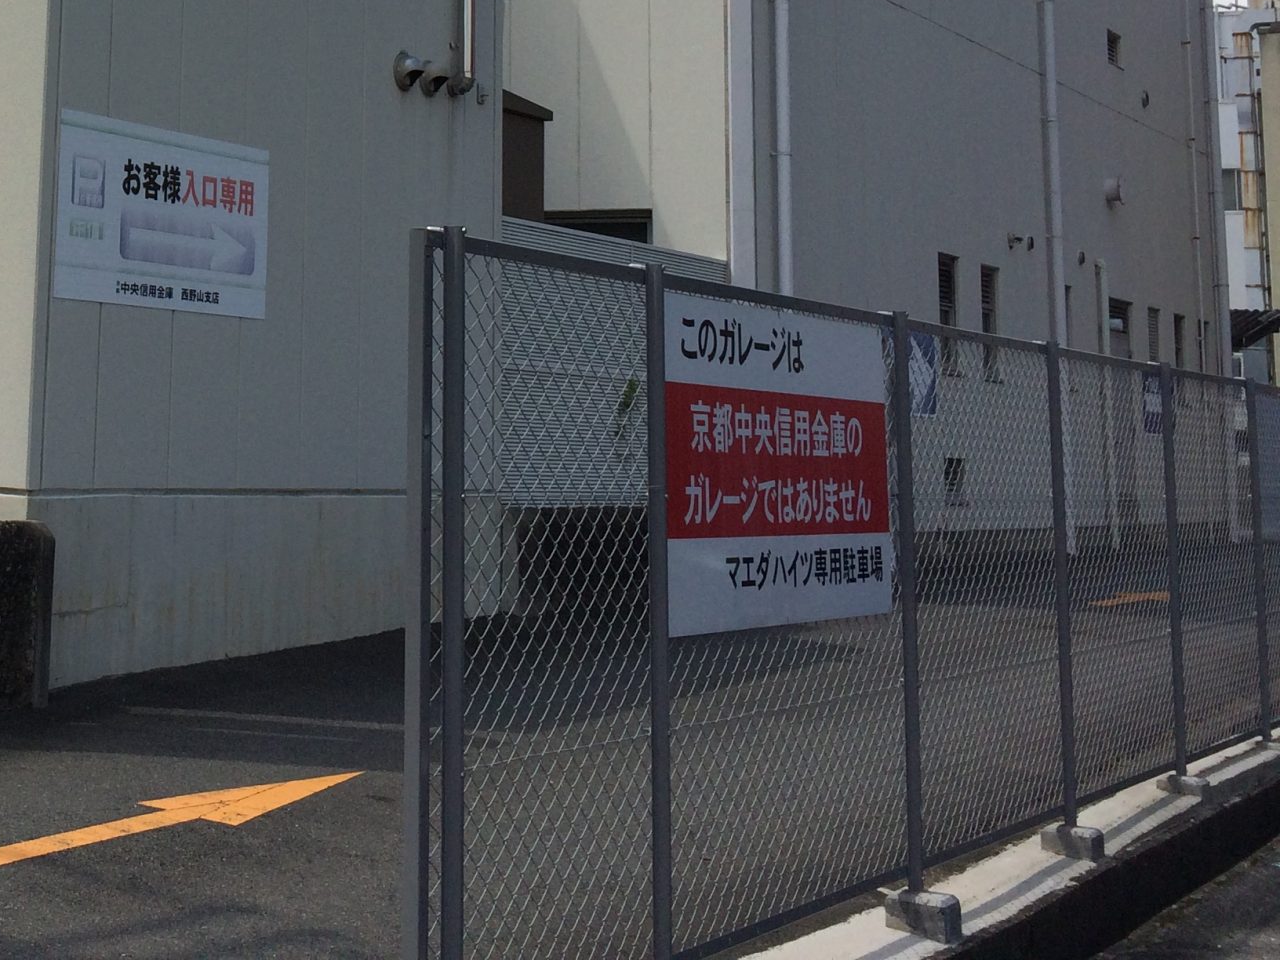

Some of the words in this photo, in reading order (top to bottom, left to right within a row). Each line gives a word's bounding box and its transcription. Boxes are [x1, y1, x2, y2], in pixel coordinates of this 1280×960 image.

[181, 288, 220, 304] 西野山支店
[680, 316, 805, 373] このガレージは
[689, 400, 863, 458] 京都中央信用金庫の
[684, 472, 871, 525] ガレージではありません
[725, 546, 884, 590] マエダハイツ専用駐車場
